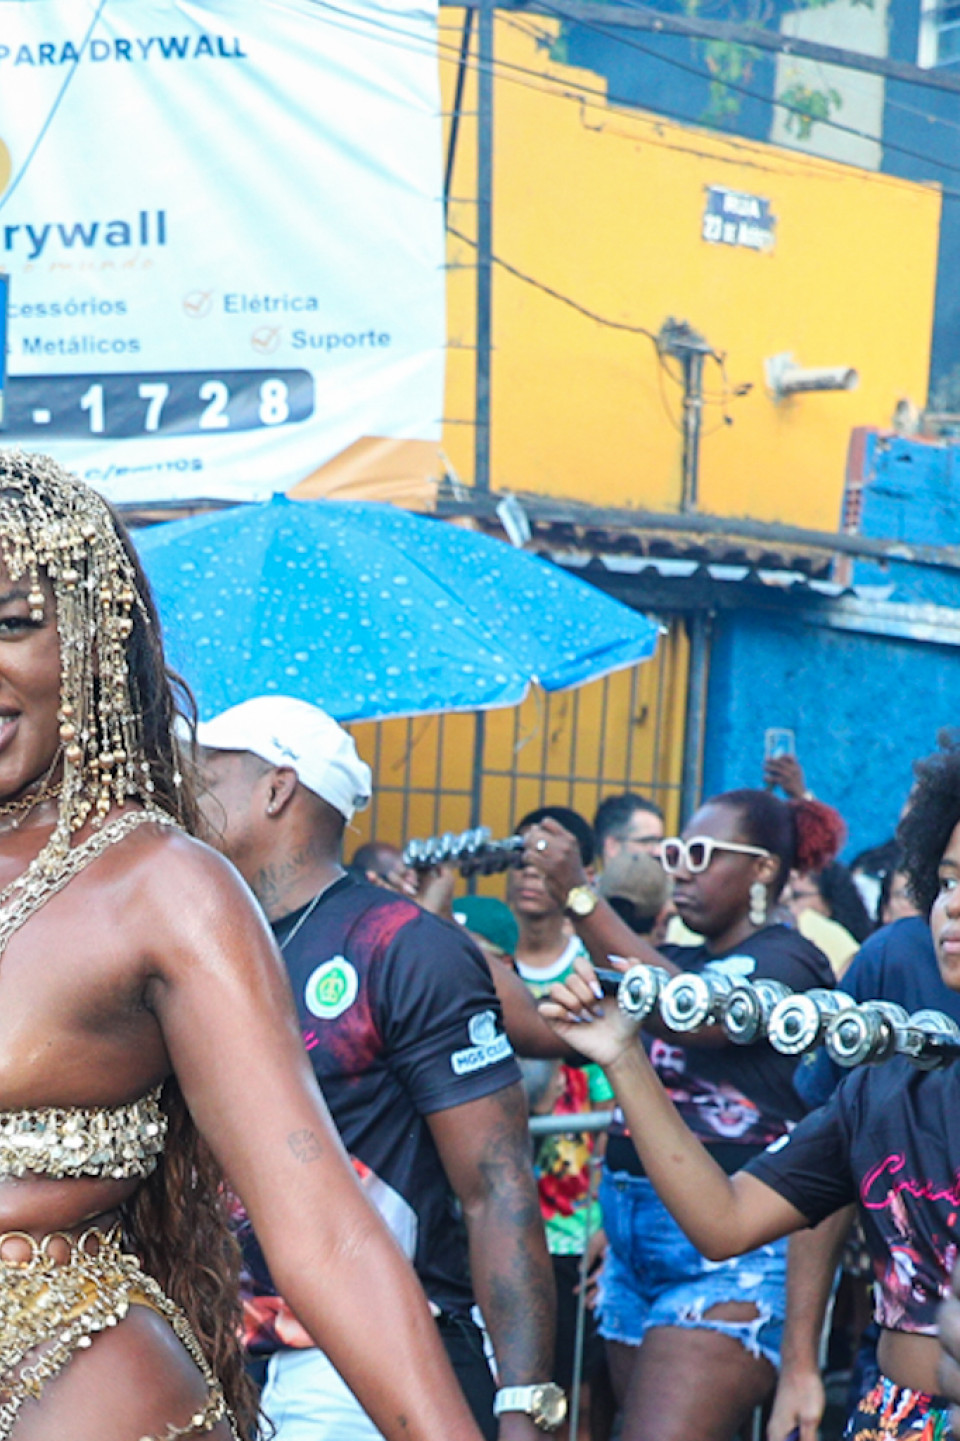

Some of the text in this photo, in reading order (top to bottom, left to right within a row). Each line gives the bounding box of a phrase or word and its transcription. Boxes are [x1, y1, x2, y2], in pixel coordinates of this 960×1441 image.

[89, 34, 247, 61] DRYWALL
[223, 293, 320, 314] Elétrica
[22, 334, 141, 355] Metálicos
[291, 328, 392, 353] Suporte
